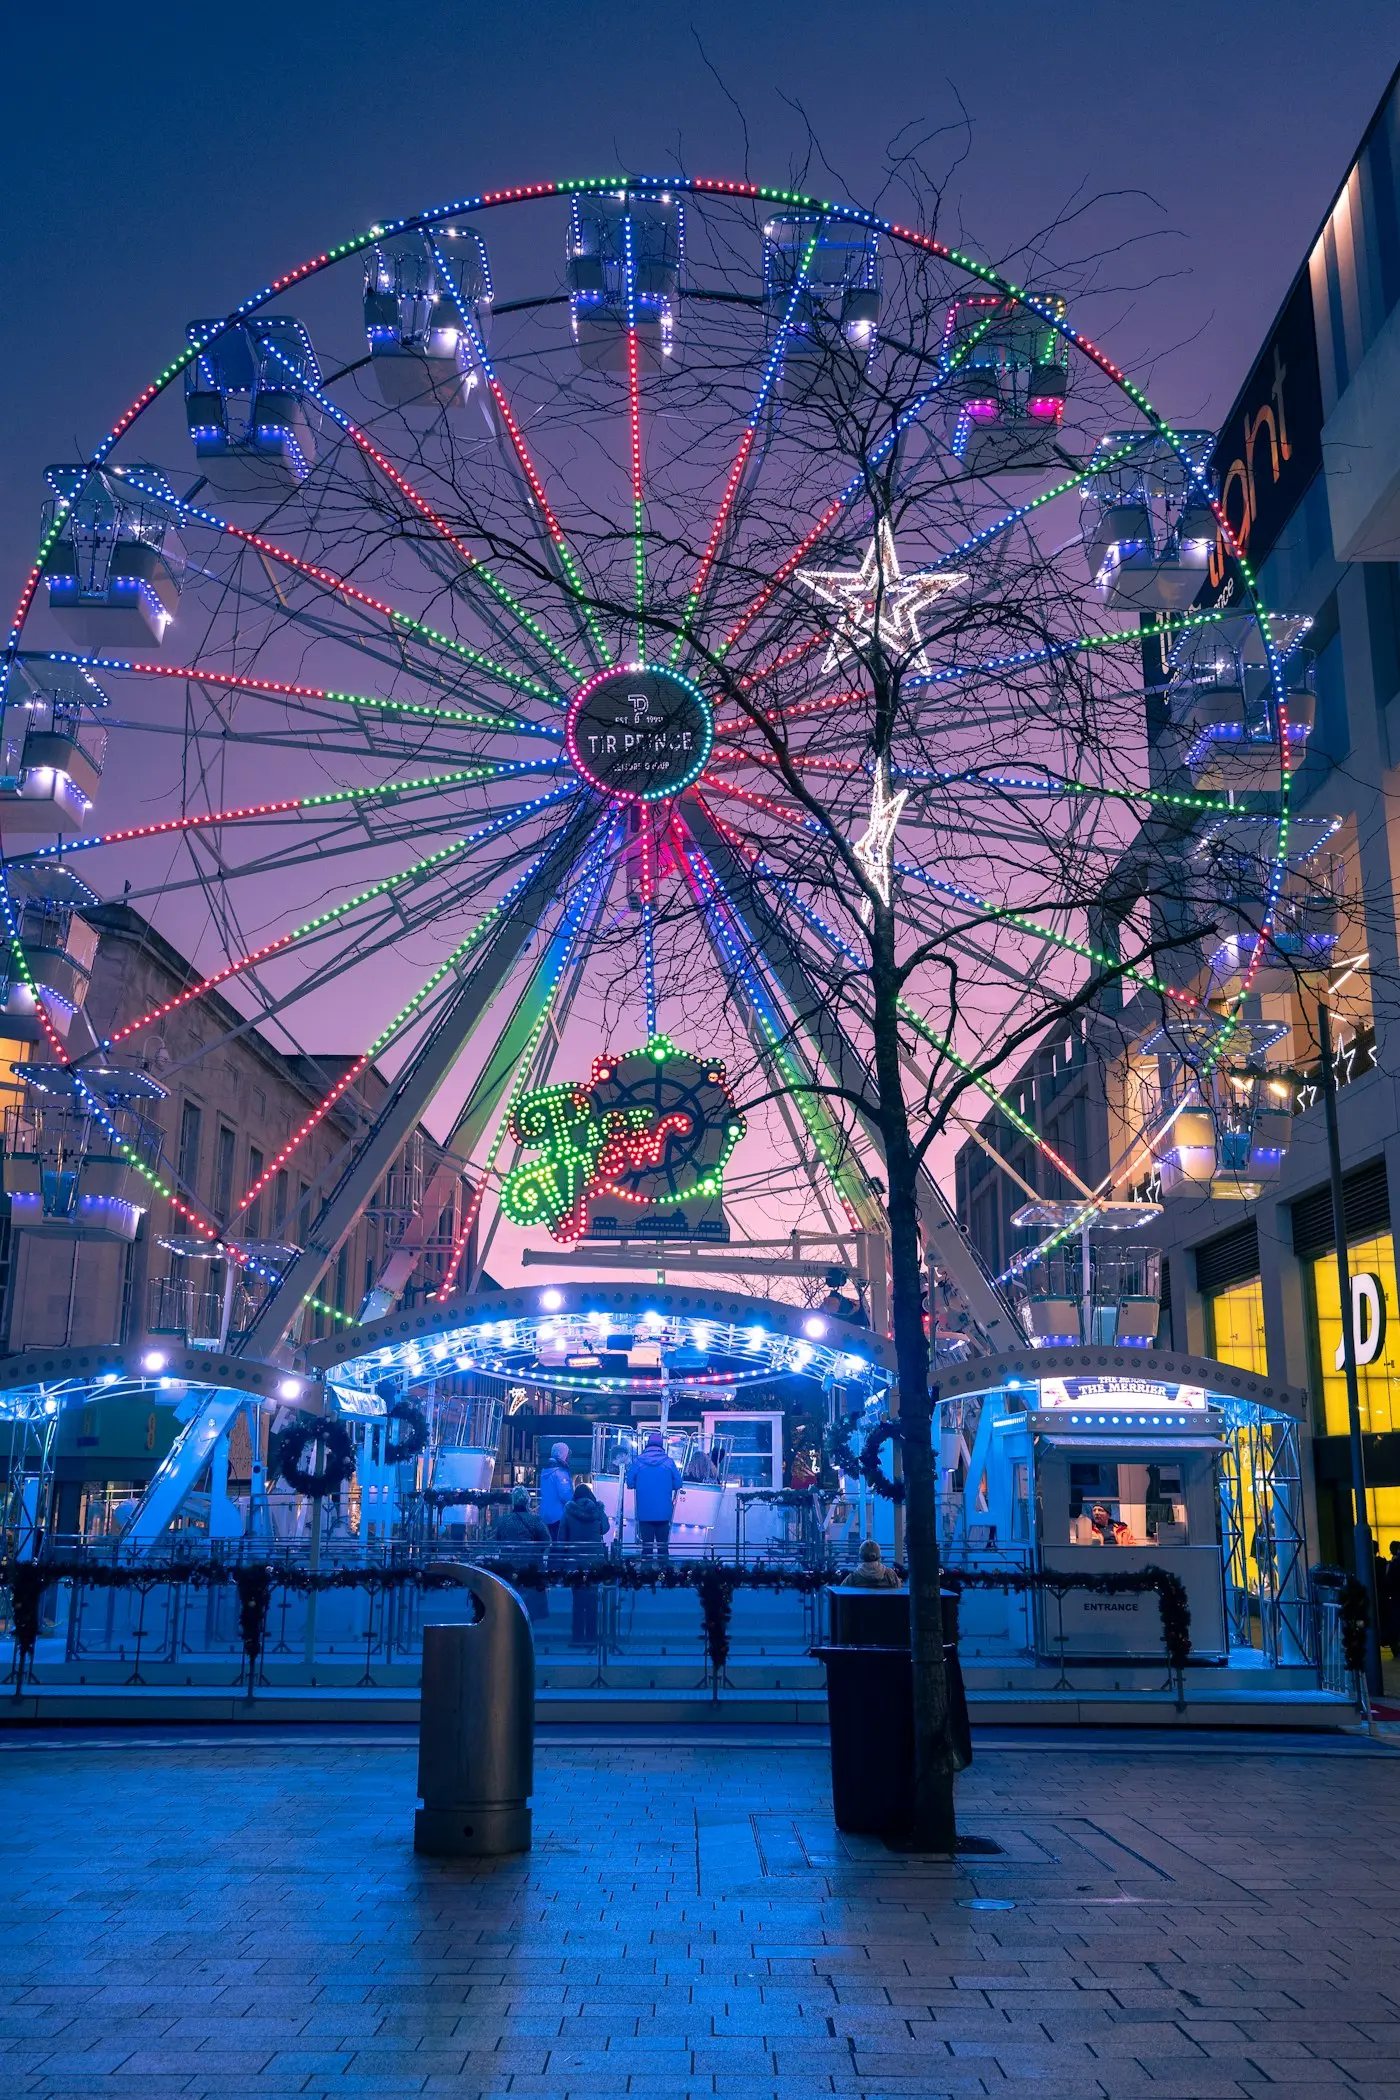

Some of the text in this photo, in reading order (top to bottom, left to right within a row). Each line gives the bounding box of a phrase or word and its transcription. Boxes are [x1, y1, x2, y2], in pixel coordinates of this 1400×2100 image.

[1078, 1382, 1167, 1396] THE MERRIER
[1084, 1603, 1139, 1612] ENTRANCE
